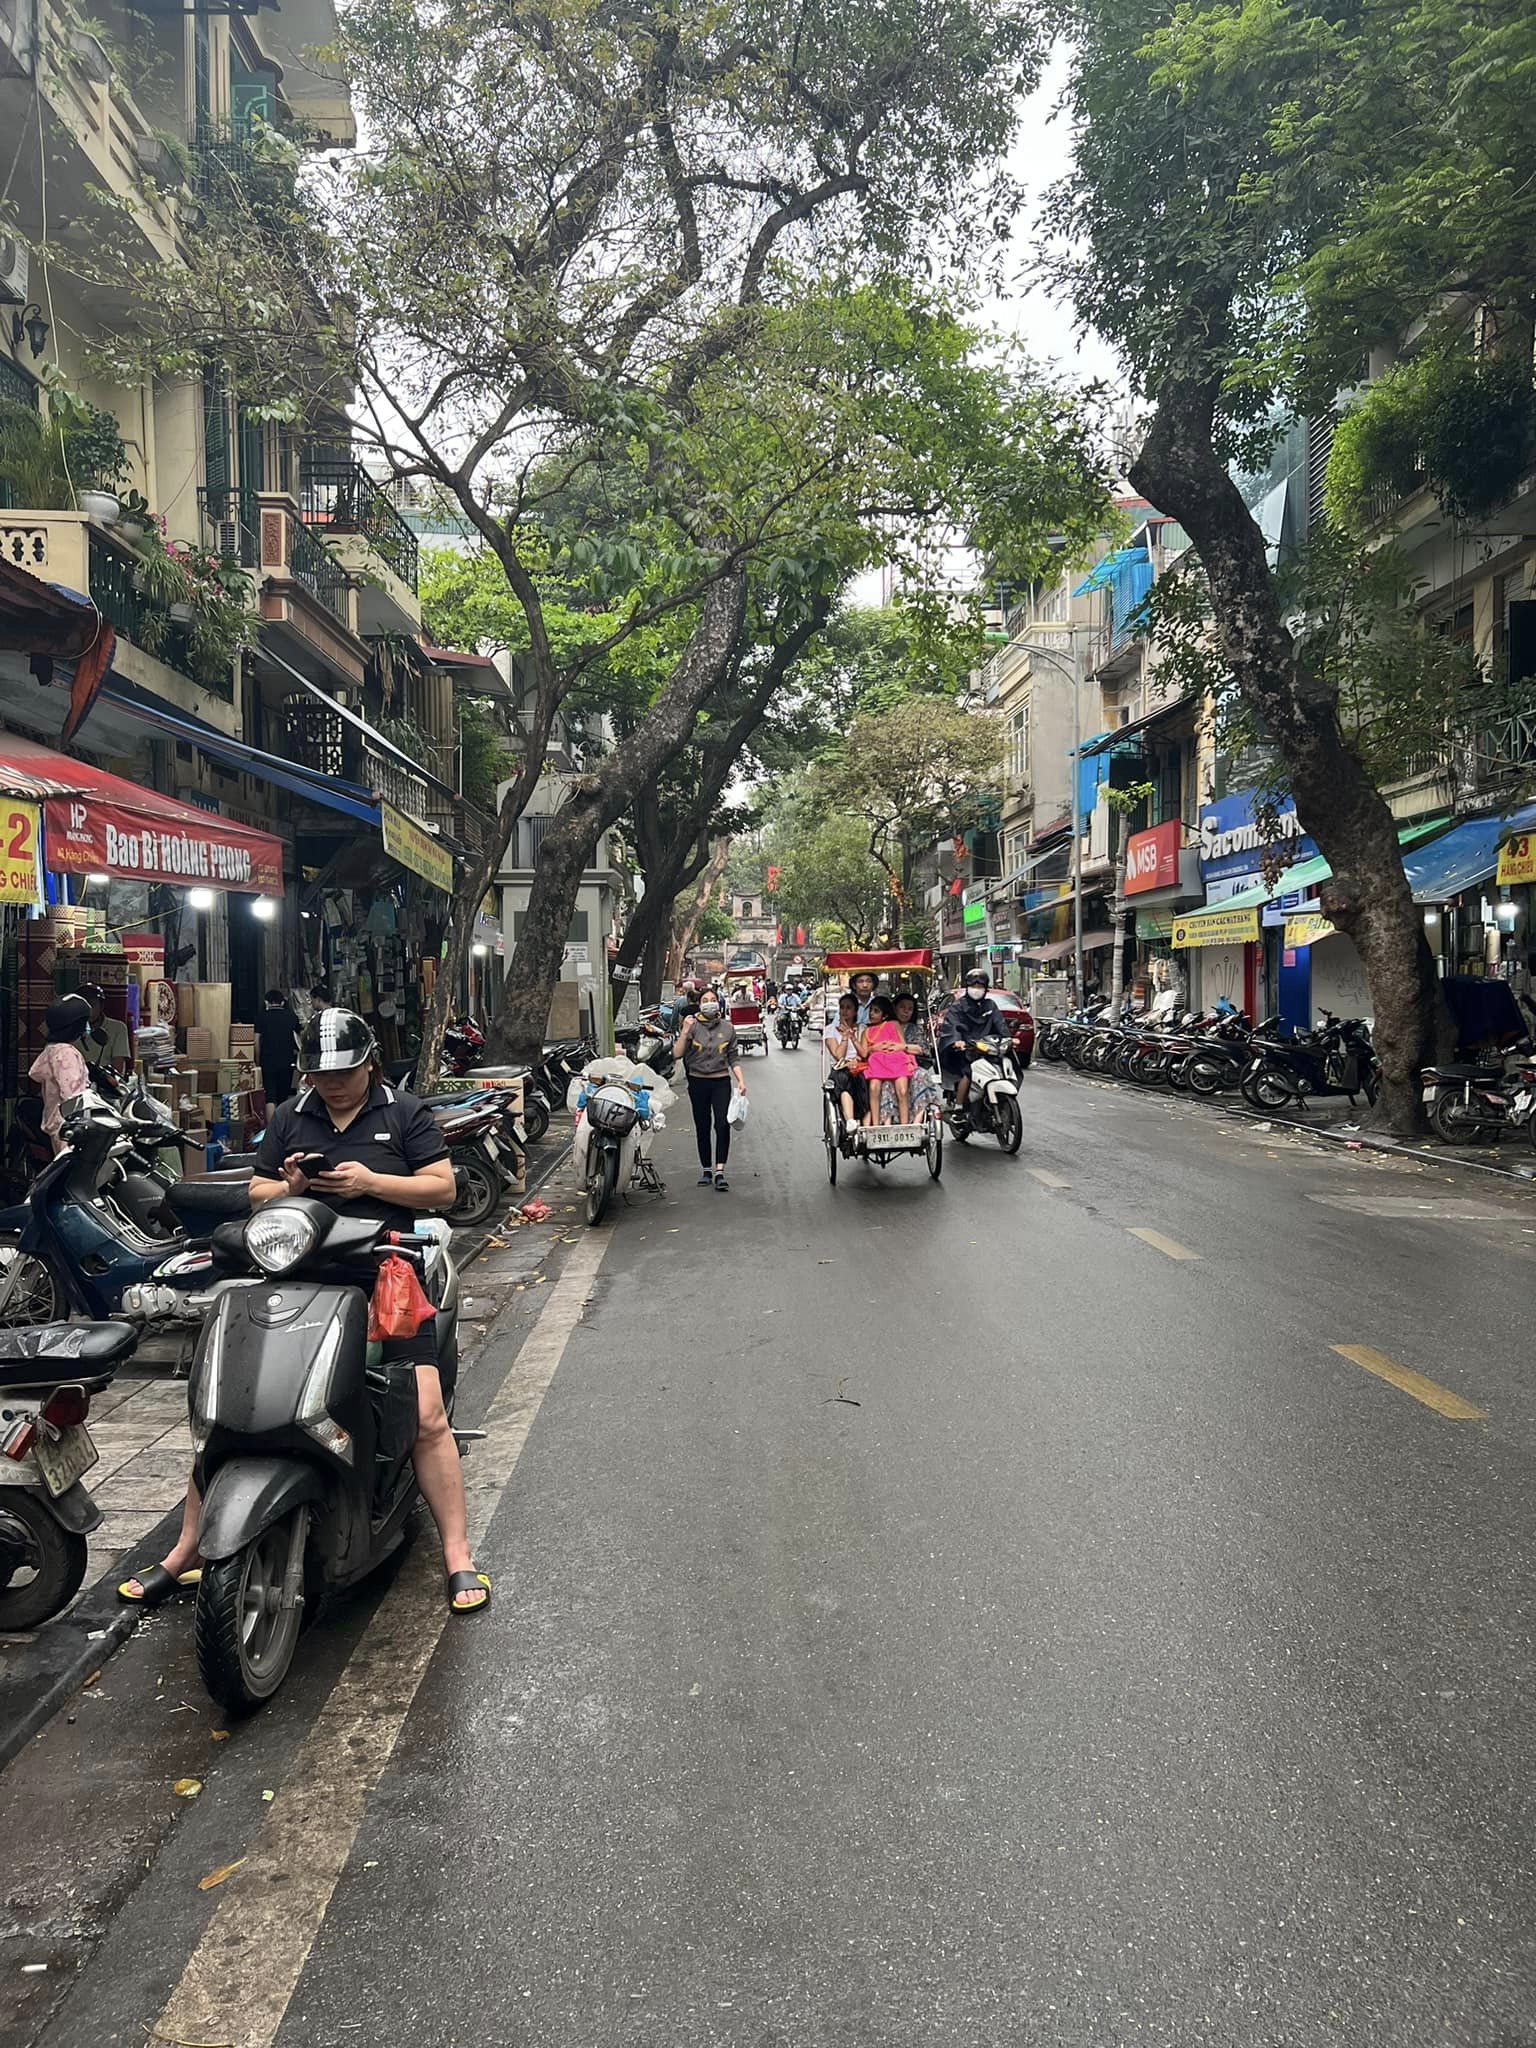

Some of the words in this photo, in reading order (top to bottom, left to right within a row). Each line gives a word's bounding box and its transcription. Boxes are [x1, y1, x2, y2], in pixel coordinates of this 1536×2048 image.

[0, 812, 33, 861] 2
[105, 823, 138, 868] Bao
[141, 830, 158, 870] Bì
[160, 830, 208, 877] HOÀNG
[209, 842, 251, 882] PHONG
[1137, 843, 1157, 875] MSB
